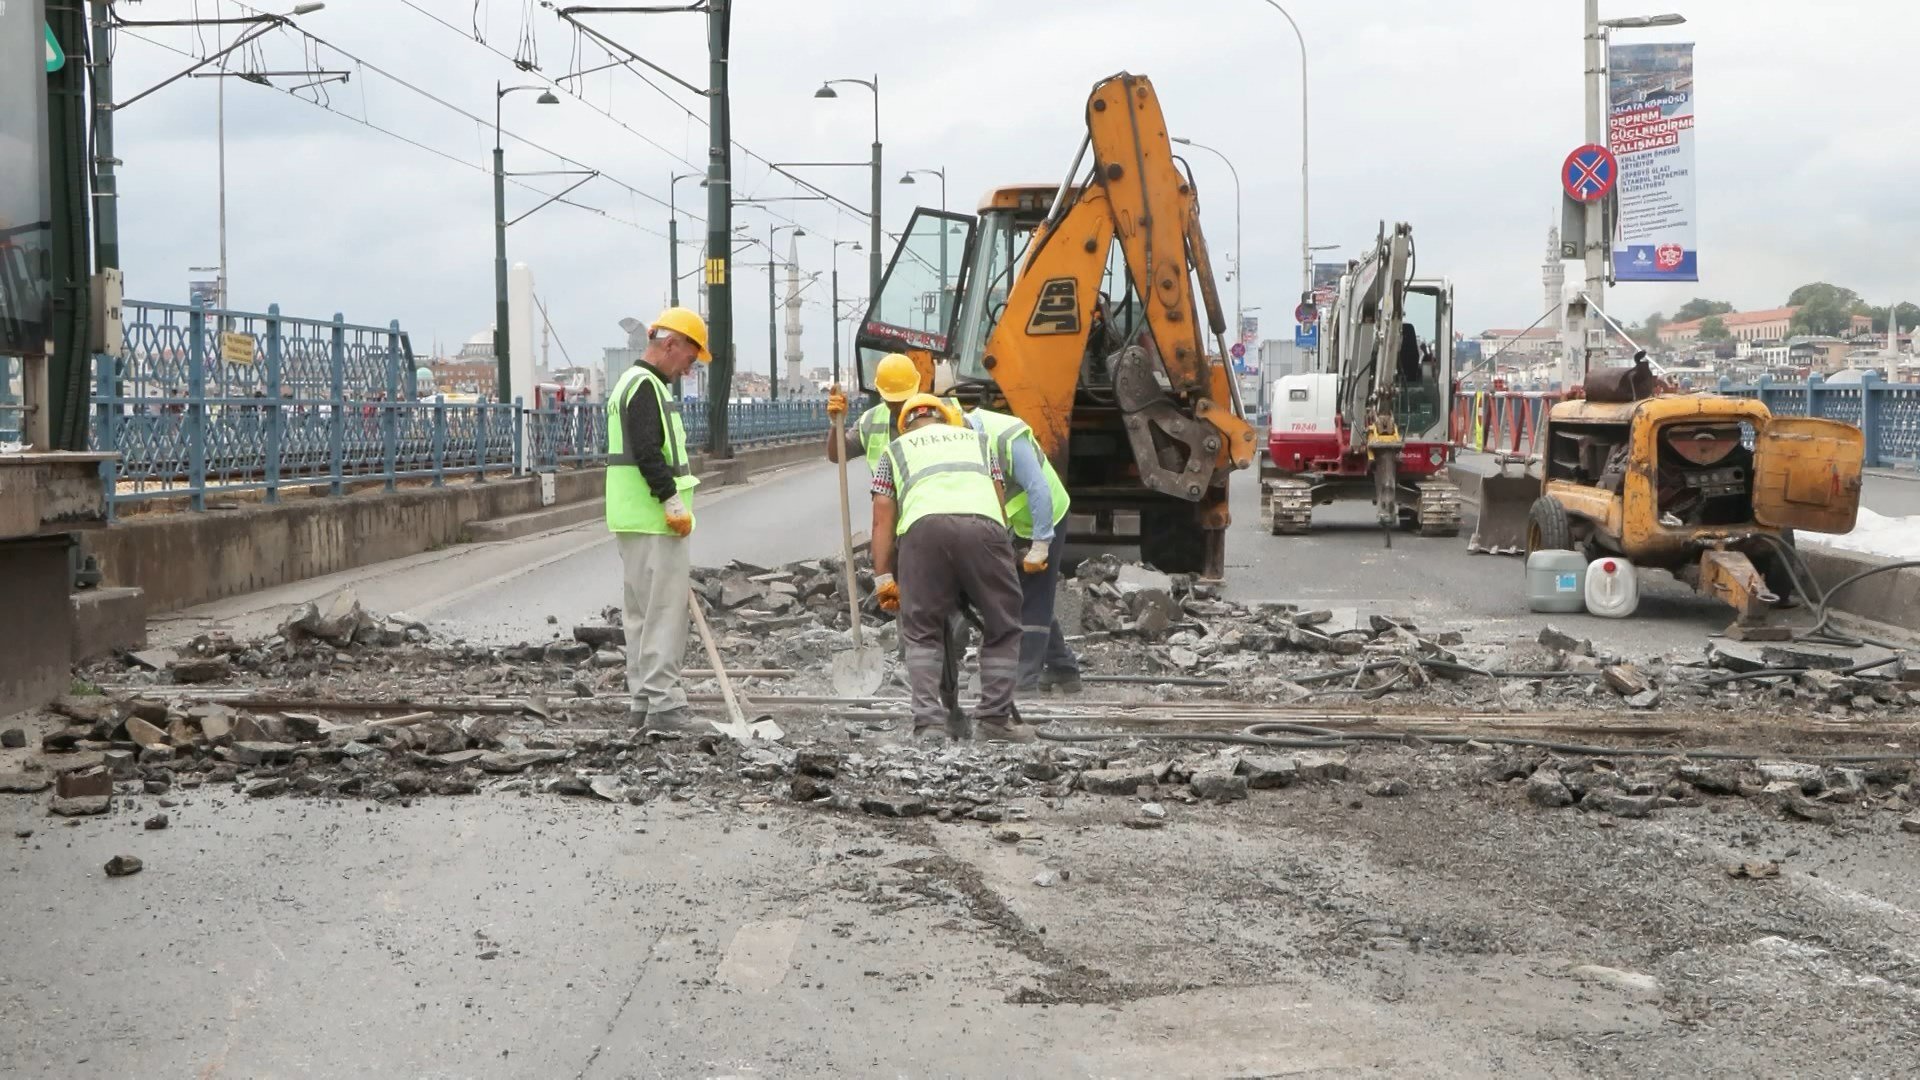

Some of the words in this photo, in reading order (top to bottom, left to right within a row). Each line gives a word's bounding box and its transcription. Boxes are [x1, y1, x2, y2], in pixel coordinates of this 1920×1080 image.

[1612, 103, 1643, 113] ALATA
[1610, 111, 1659, 127] DEPREM
[1032, 281, 1077, 330] JCB
